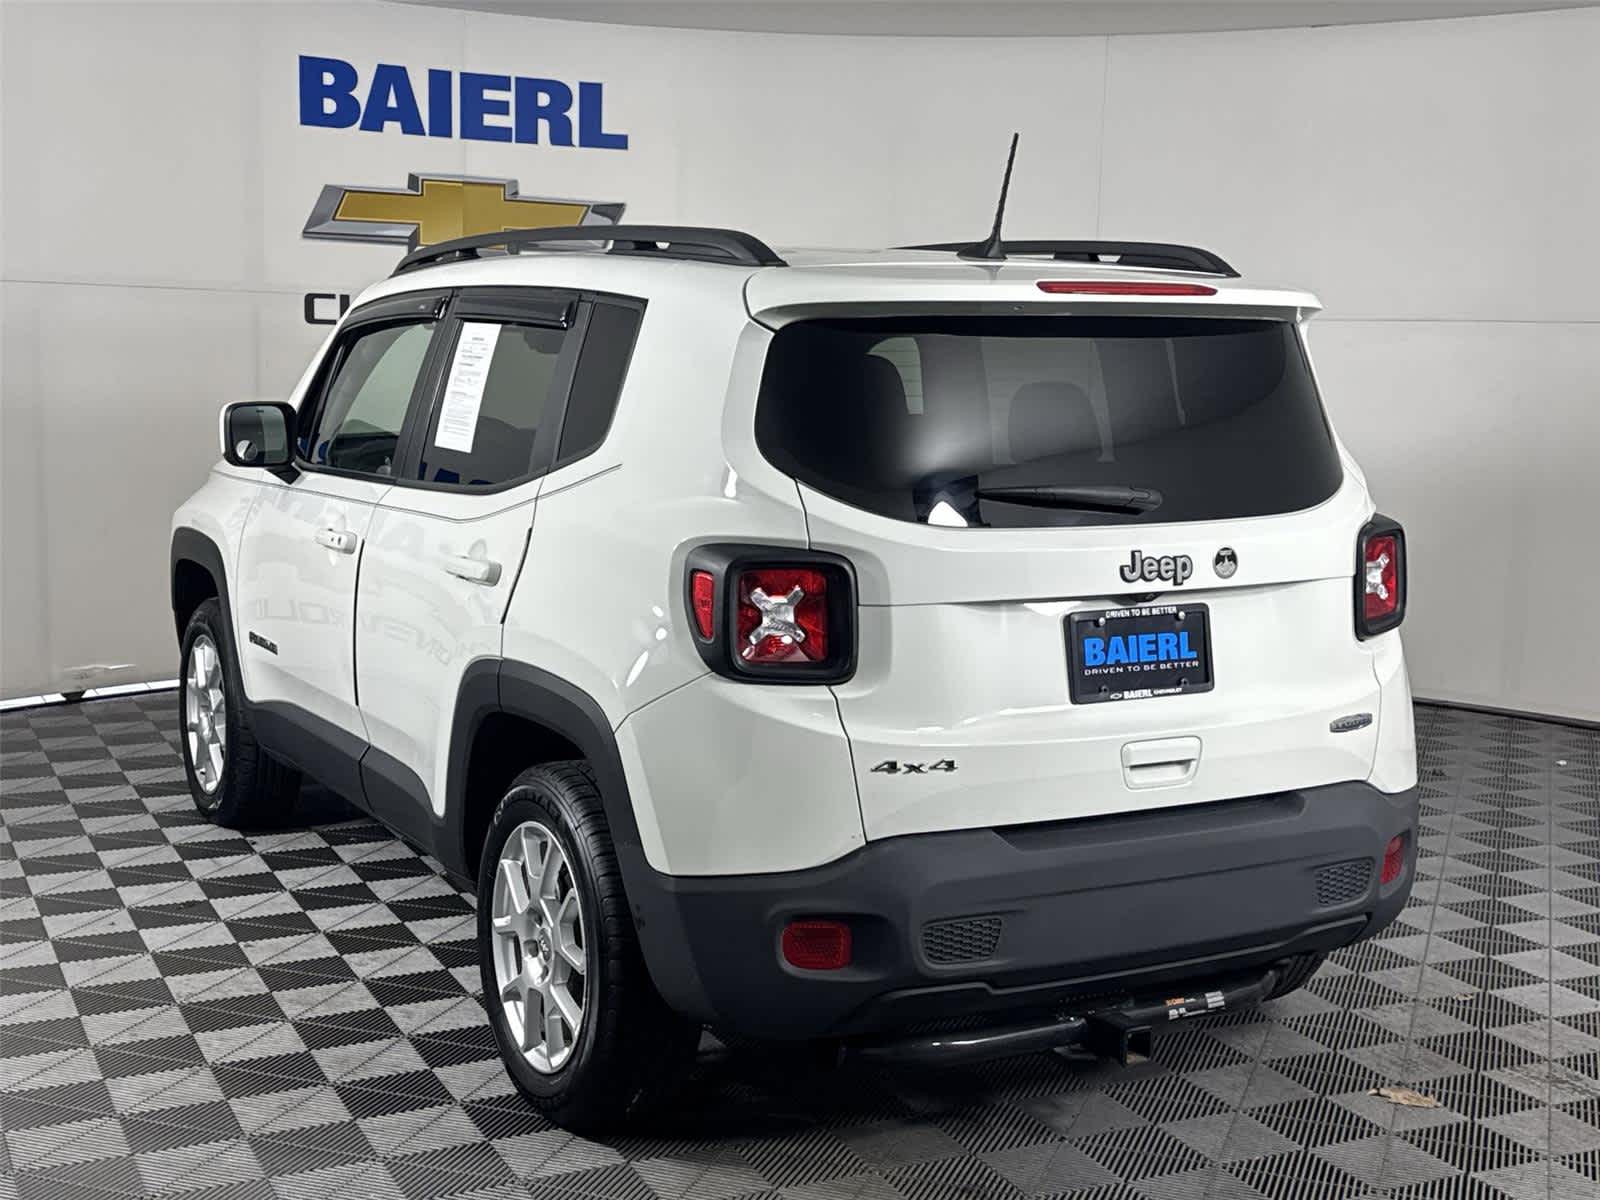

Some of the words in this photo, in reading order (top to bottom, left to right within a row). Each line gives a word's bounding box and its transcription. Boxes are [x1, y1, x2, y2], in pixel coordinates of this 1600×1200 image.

[298, 55, 628, 150] BAIERL
[1120, 550, 1193, 586] Jeep
[1106, 609, 1130, 618] DRIVEN
[1131, 608, 1141, 616] TO
[1141, 607, 1151, 616] BE
[1152, 606, 1177, 615] BETTER
[1084, 631, 1197, 666] BAIERL
[1084, 666, 1124, 676] DRIVEN
[1159, 660, 1200, 669] BETTER
[1123, 688, 1153, 699] BAIERL
[870, 759, 959, 774] 4x4
